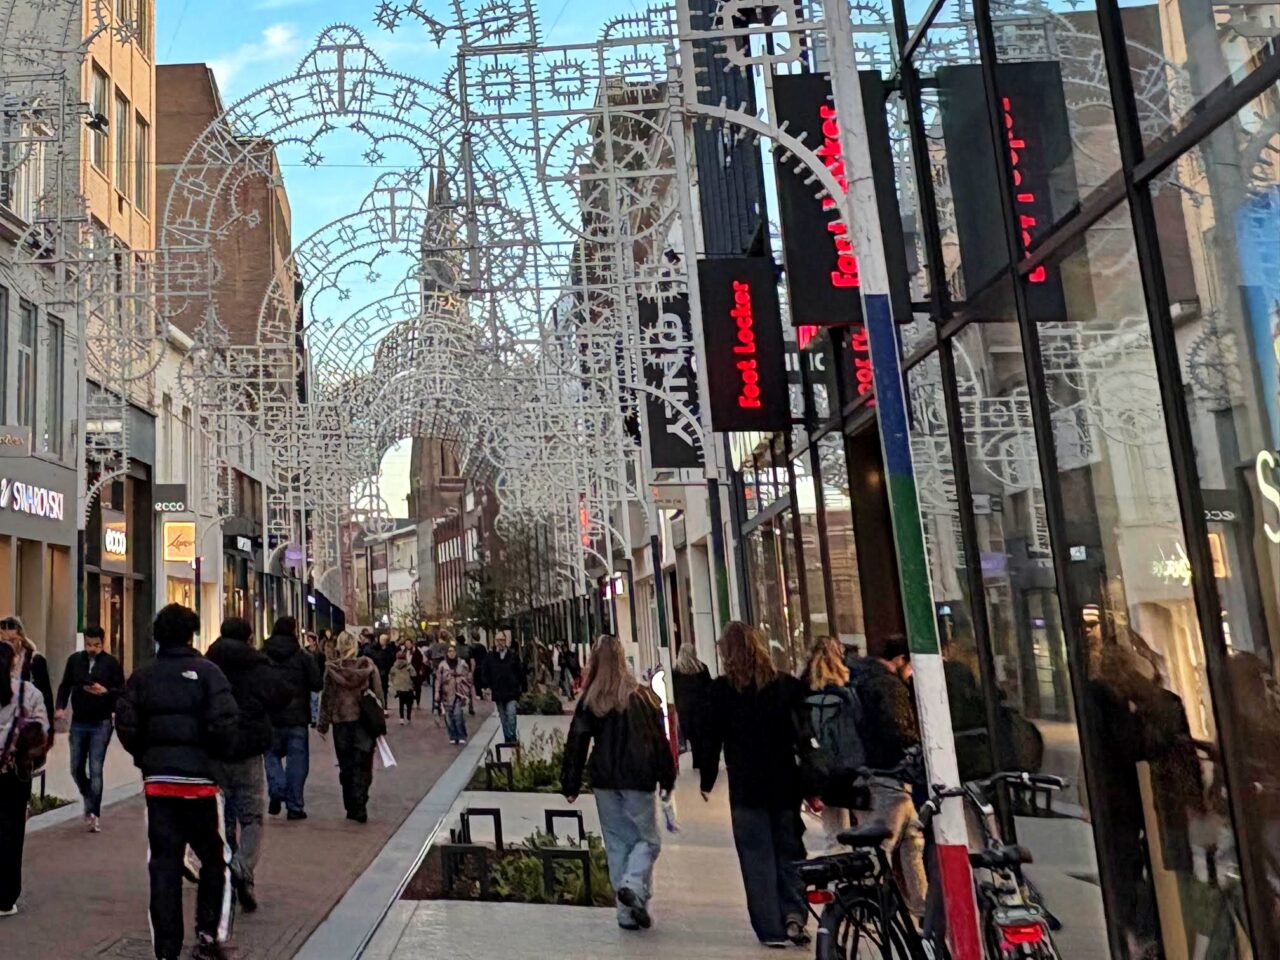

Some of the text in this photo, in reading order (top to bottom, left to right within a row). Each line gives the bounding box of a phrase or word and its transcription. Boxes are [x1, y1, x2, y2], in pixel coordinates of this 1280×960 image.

[731, 280, 761, 407] Foot Locker
[13, 481, 64, 521] SWAROVSKI
[154, 502, 184, 512] ecco
